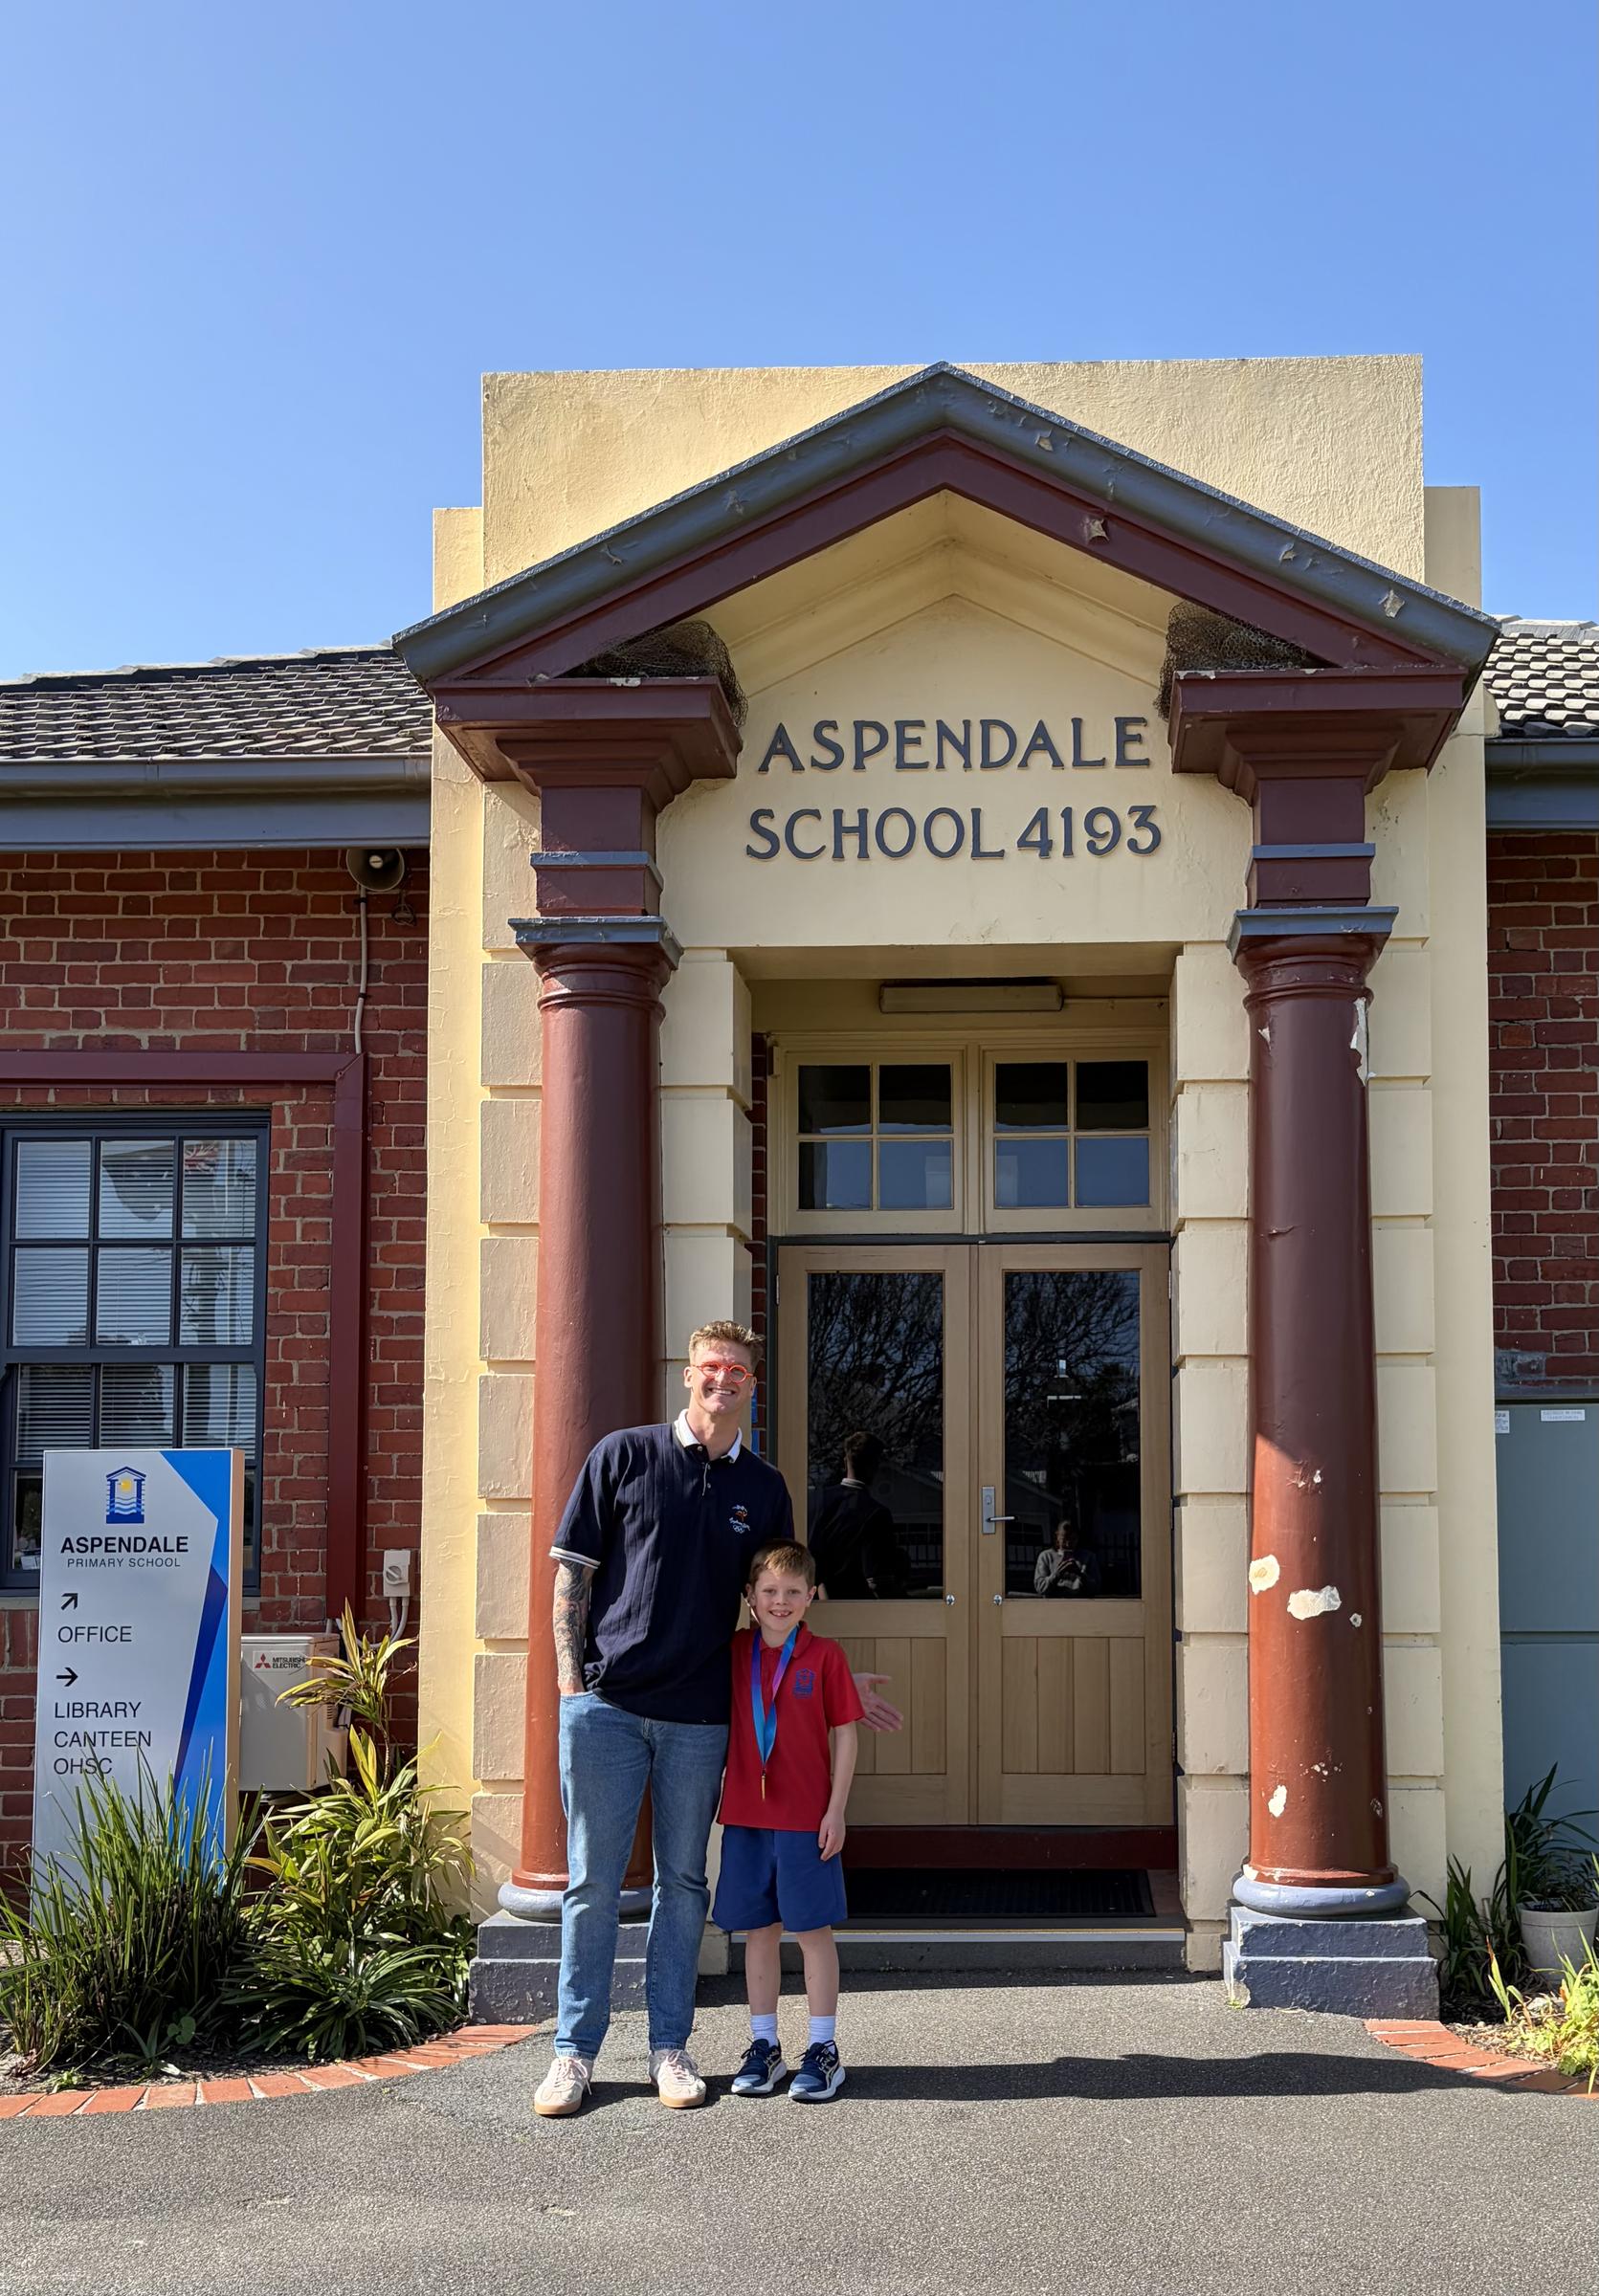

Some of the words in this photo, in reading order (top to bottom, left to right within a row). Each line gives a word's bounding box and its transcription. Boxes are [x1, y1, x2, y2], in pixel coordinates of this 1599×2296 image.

[758, 717, 1151, 773] ASPENDALE
[746, 806, 1005, 860] SCHOOL
[1016, 805, 1163, 859] 4193
[60, 1536, 189, 1554] ASPENDALE
[67, 1558, 123, 1568] PRIMARY
[128, 1557, 181, 1568] SCHOOL
[57, 1625, 132, 1643] OFFICE
[55, 1702, 142, 1718] LIBRARY
[54, 1731, 151, 1748] CANTEEN
[54, 1757, 113, 1775] OHSC
